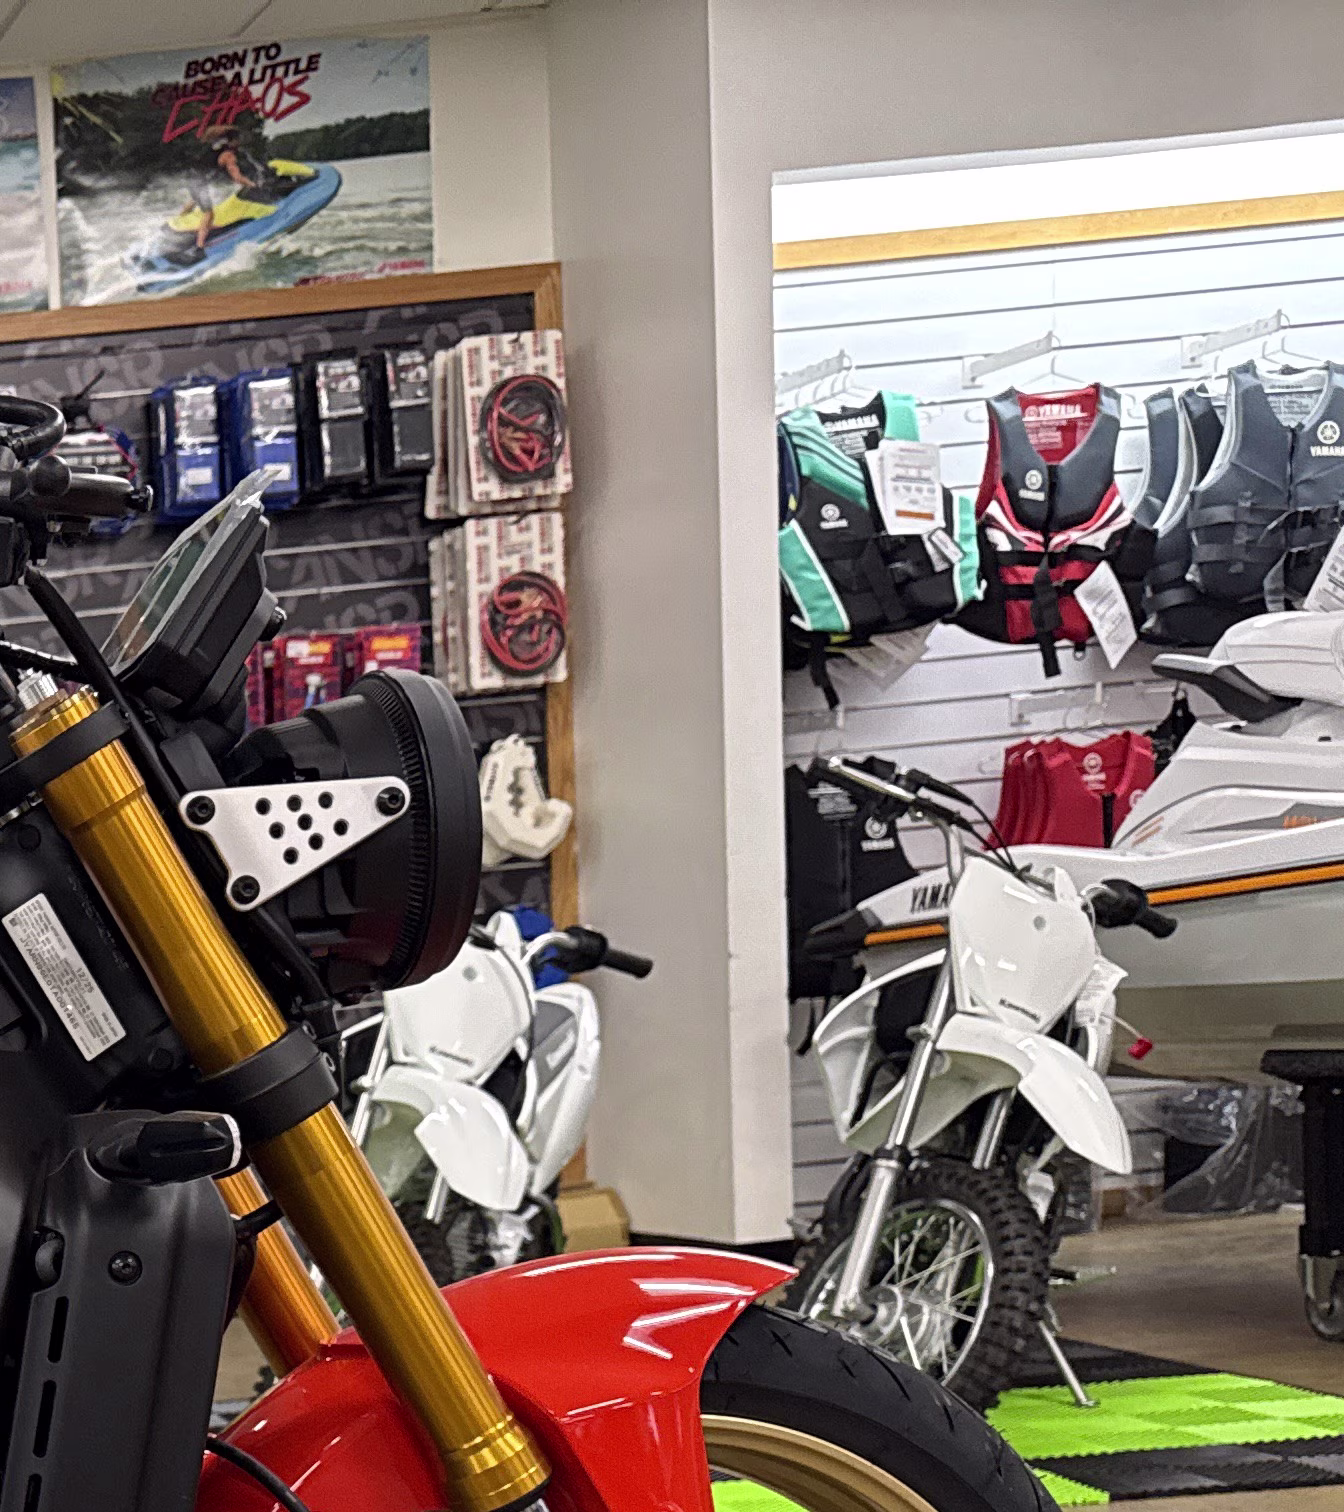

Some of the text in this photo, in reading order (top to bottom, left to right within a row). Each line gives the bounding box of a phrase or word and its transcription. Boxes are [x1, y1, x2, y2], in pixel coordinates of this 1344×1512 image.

[184, 42, 282, 79] BORN TO
[248, 52, 323, 87] LITTLE
[163, 74, 311, 144] CHAOS
